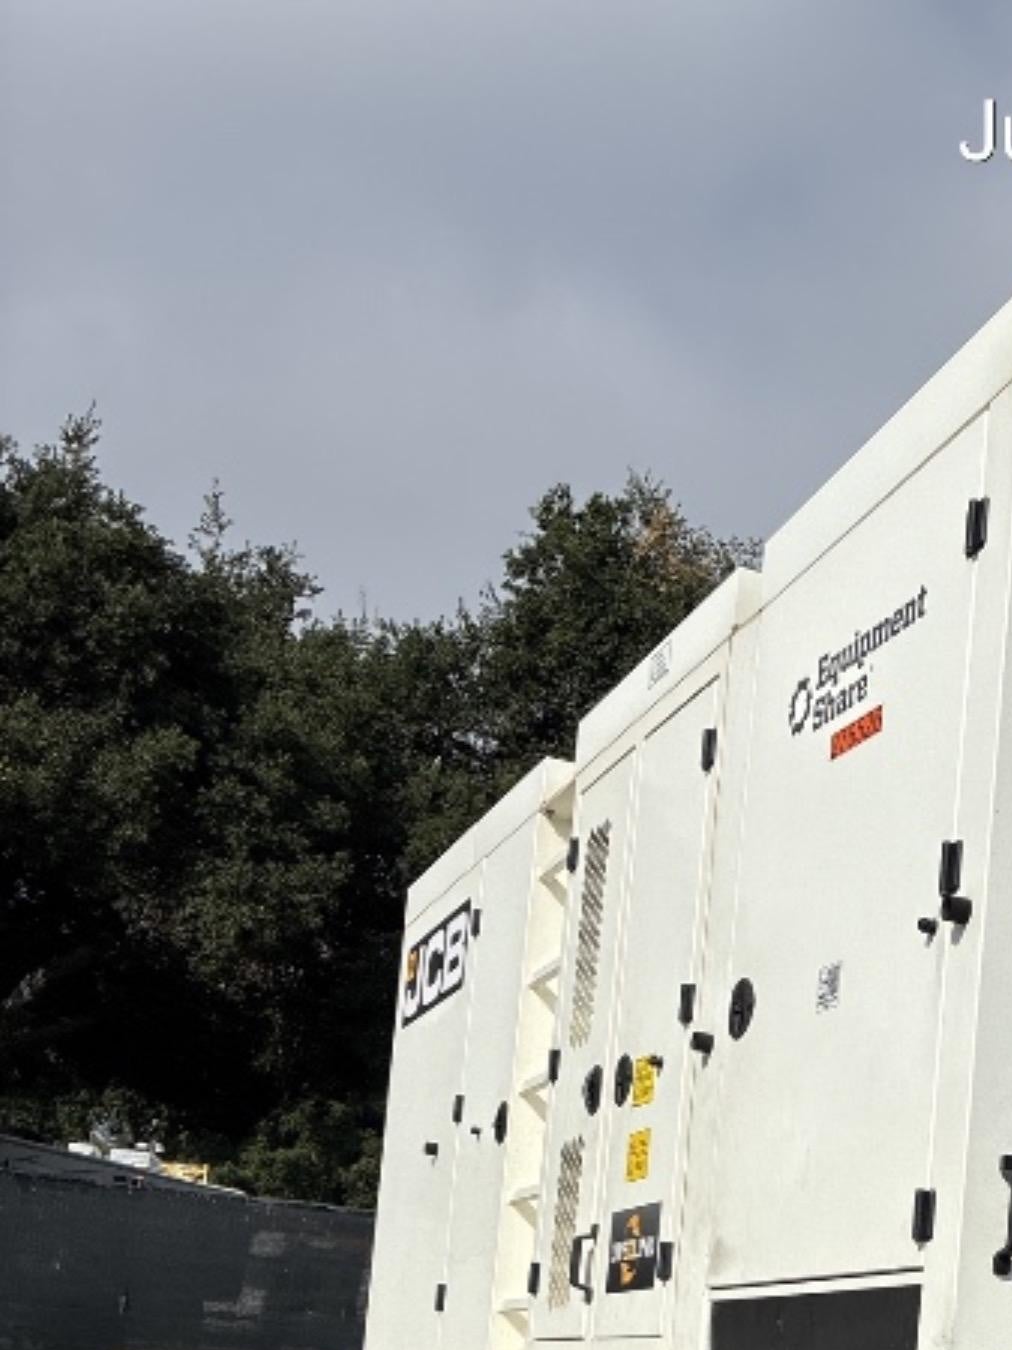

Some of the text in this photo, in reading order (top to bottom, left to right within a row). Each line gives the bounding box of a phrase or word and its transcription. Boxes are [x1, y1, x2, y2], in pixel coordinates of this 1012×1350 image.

[815, 584, 928, 690] Equipment
[812, 673, 868, 732] Share
[403, 907, 469, 1020] JCB
